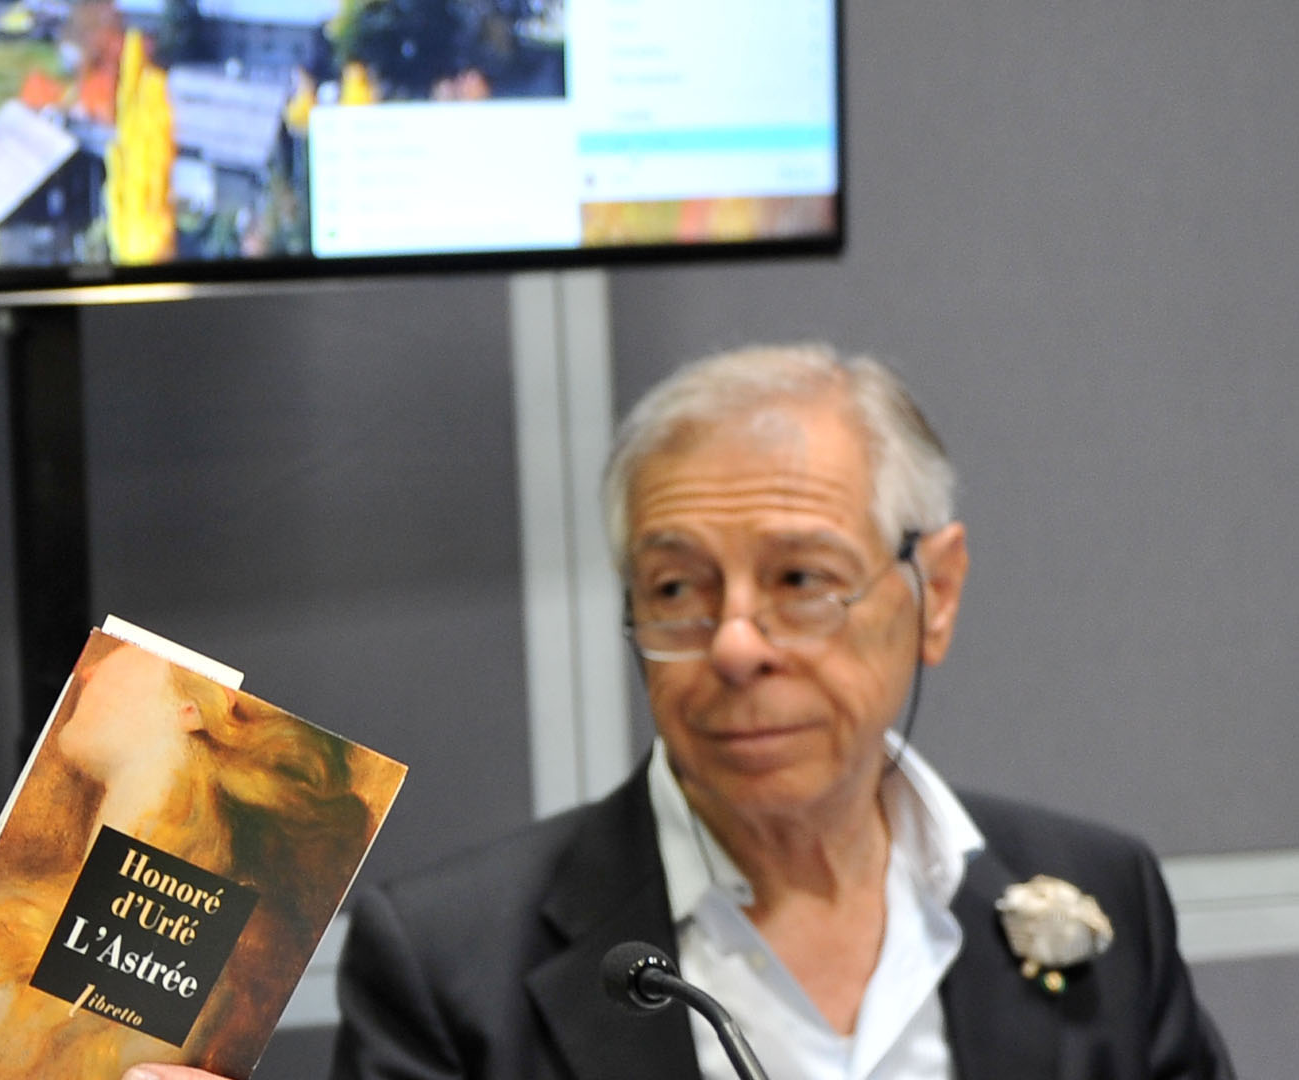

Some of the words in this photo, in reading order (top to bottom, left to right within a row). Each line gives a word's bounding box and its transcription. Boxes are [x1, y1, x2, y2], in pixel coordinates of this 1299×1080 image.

[118, 848, 224, 915] Honoré
[111, 891, 199, 946] d'Urfé
[63, 915, 198, 999] L'Astrée
